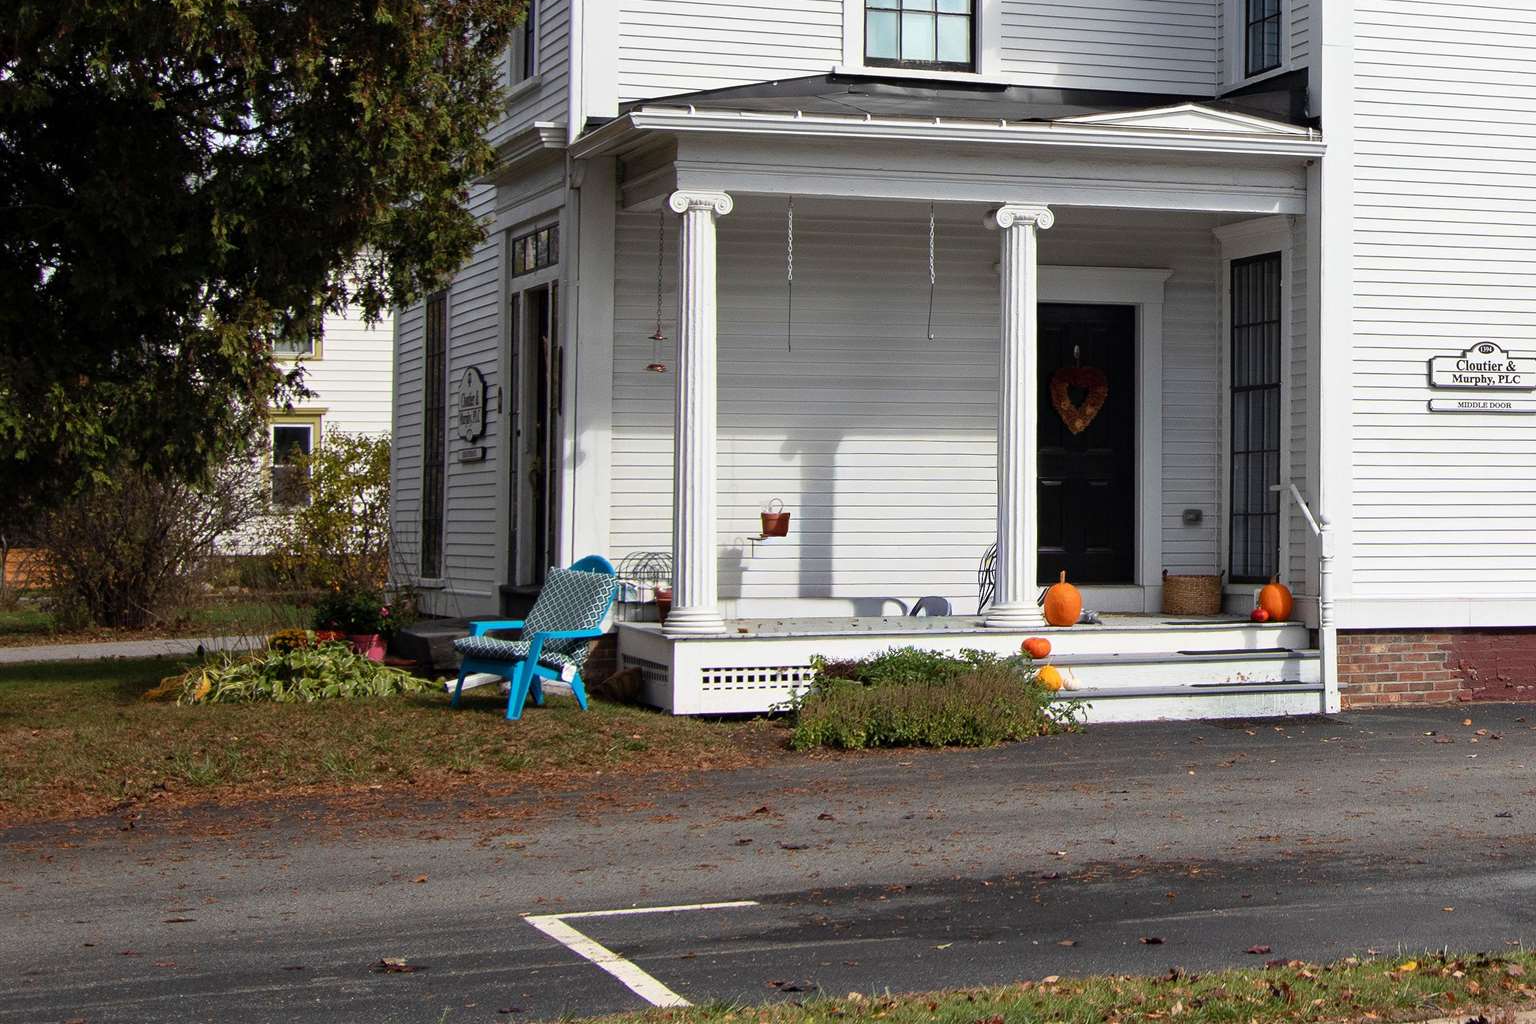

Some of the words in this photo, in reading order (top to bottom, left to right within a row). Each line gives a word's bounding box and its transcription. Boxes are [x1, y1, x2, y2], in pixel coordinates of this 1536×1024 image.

[1456, 359, 1503, 372] Cloutier
[1506, 361, 1516, 372] &
[1452, 374, 1495, 386] Murphy,
[1498, 375, 1521, 384] PLC
[1457, 401, 1488, 409] MIDDLE
